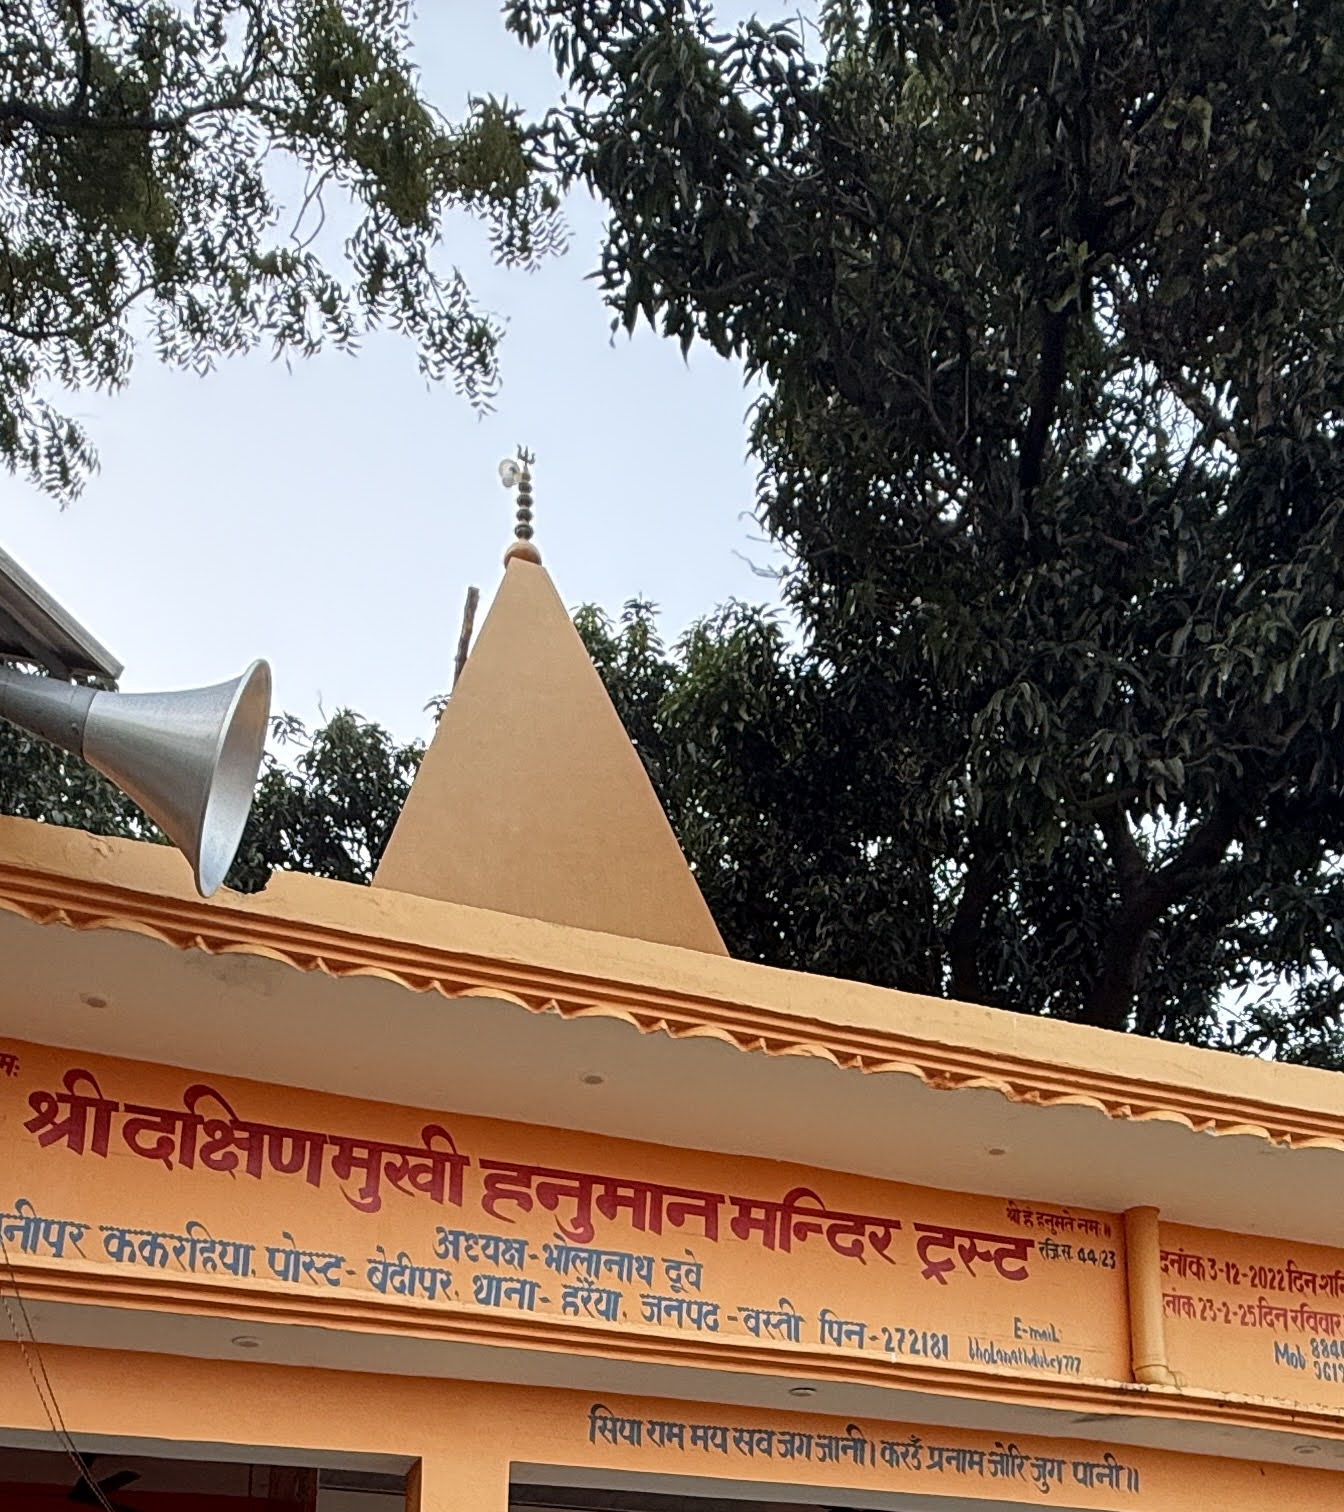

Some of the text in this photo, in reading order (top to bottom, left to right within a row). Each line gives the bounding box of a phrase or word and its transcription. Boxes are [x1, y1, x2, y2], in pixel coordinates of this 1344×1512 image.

[23, 1068, 119, 1158] श्री
[478, 1157, 725, 1243] हनुमान
[729, 1187, 902, 1265] मन्दिर
[913, 1222, 1035, 1285] ट्रस्ट
[1207, 1257, 1286, 1291] 3-12-2022
[1286, 1259, 1317, 1297] दिन
[1198, 1297, 1256, 1327] 23-2-25
[1256, 1297, 1289, 1332] दिन
[1289, 1302, 1344, 1338] रविवार
[688, 1424, 729, 1454] मय
[777, 1430, 813, 1461] जग
[926, 1445, 986, 1477] प्रनाम
[987, 1441, 1032, 1482] जोरि
[1030, 1456, 1066, 1494] जुग
